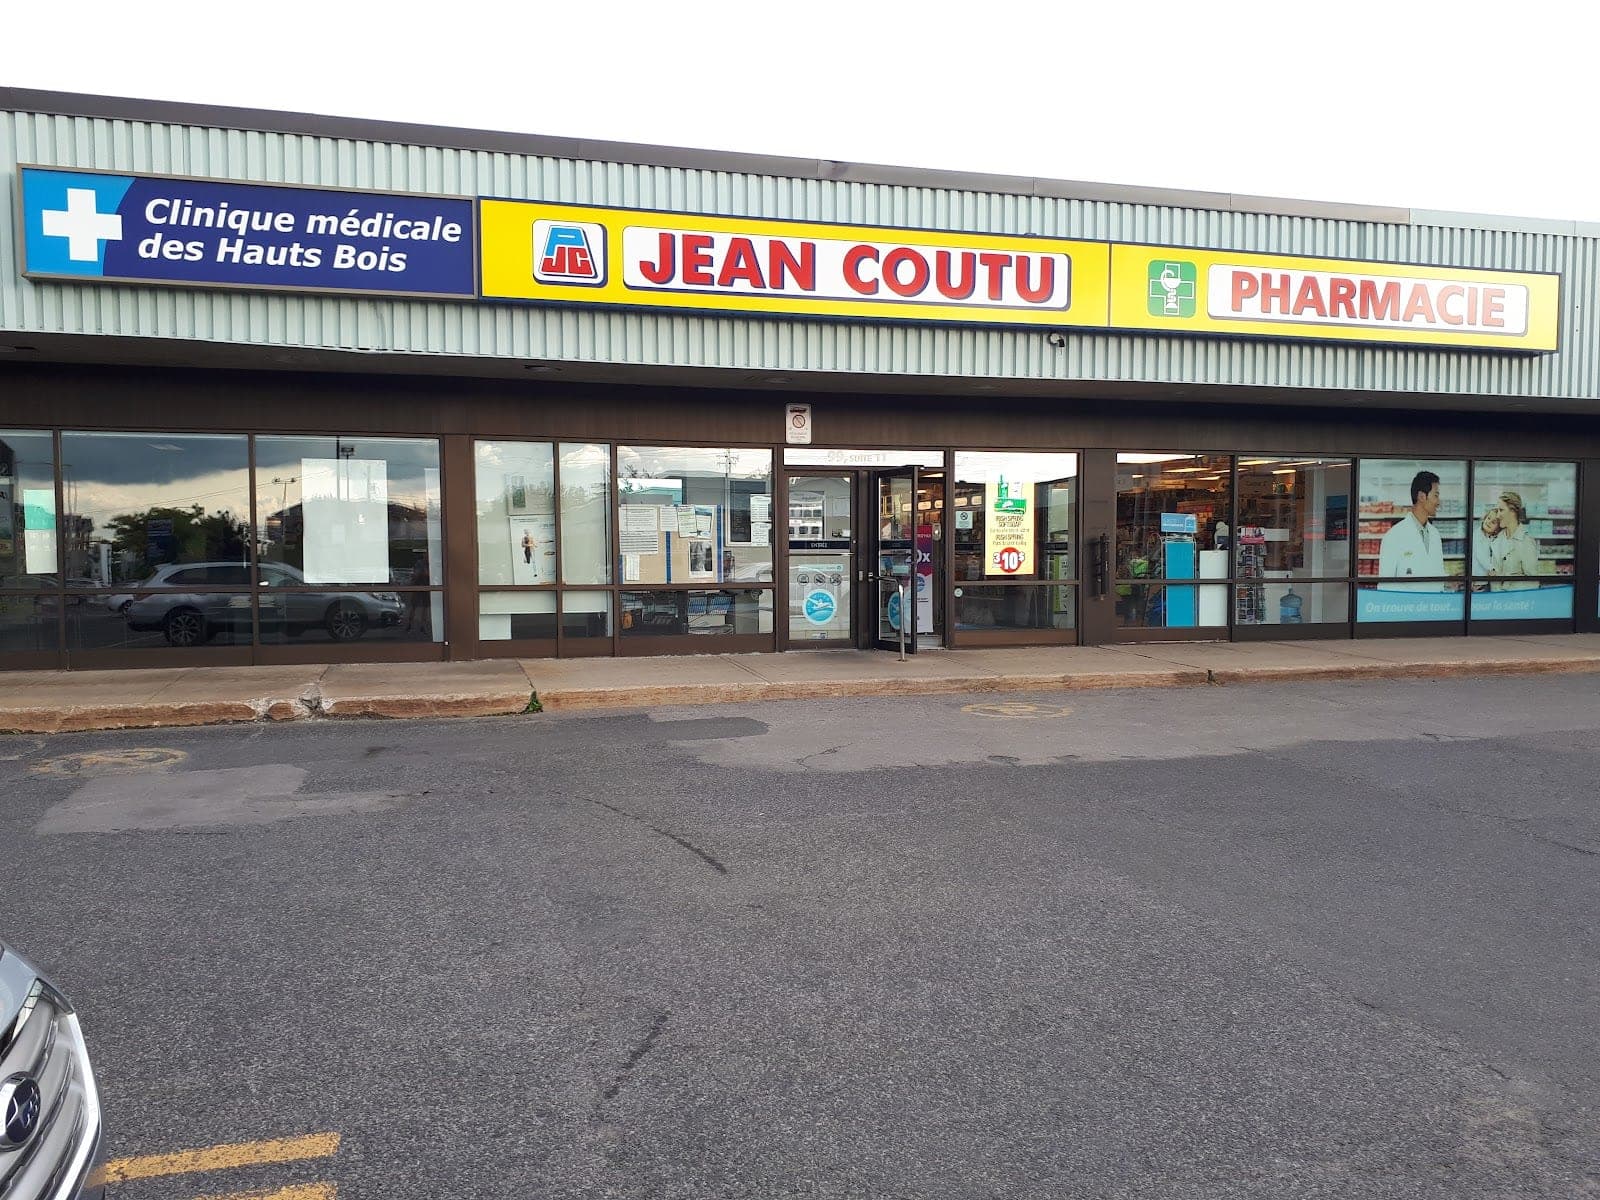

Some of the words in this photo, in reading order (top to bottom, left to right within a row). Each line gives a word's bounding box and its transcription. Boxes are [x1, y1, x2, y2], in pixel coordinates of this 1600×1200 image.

[144, 197, 296, 235] Clinique
[306, 209, 463, 242] médicale
[138, 232, 203, 262] des
[216, 237, 323, 268] Hauts
[333, 244, 408, 272] Bois
[639, 232, 816, 292] JEAN
[842, 245, 1056, 303] COUTU
[1231, 270, 1506, 328] PHARMACIE
[1365, 602, 1379, 614] On
[1381, 602, 1415, 613] trouve
[1416, 601, 1429, 612] de
